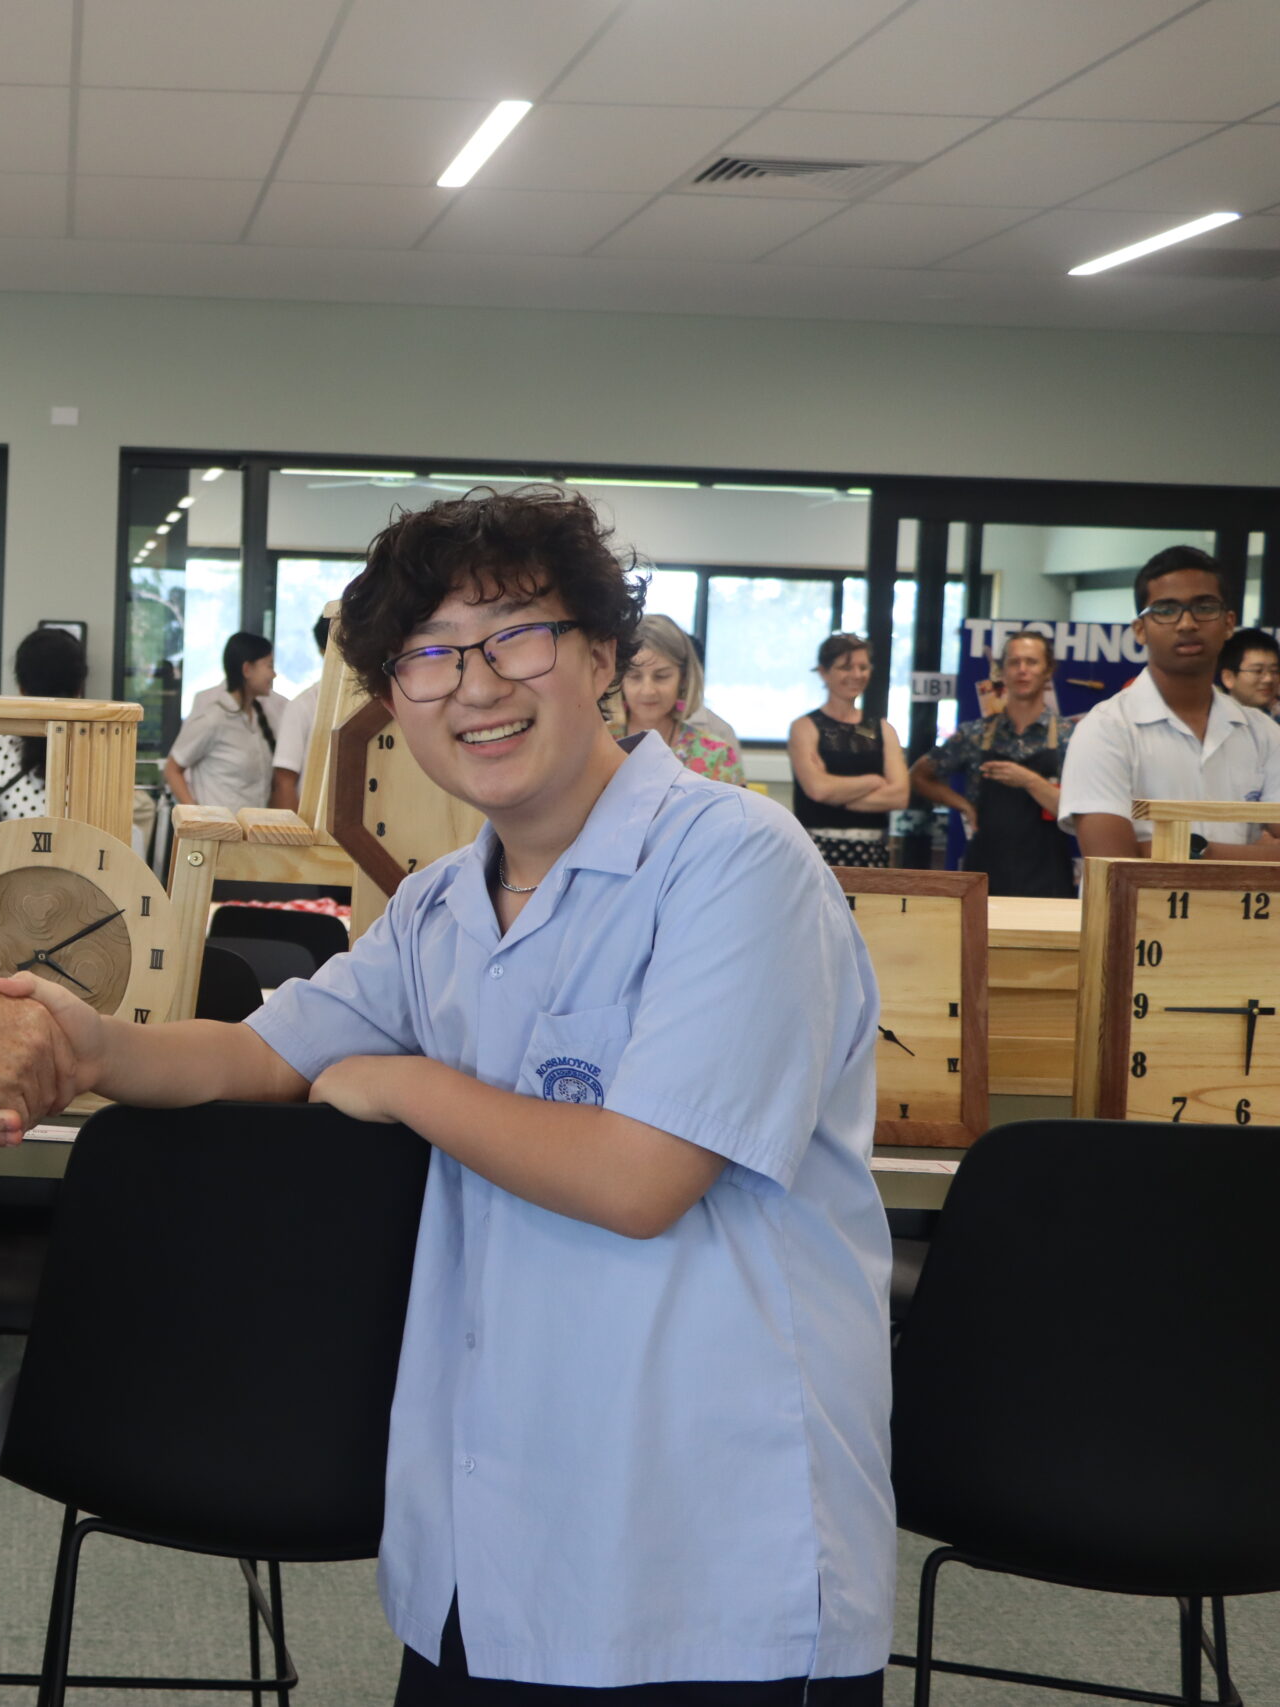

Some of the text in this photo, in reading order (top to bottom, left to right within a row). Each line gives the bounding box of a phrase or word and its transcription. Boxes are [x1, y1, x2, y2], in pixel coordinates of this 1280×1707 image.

[378, 734, 394, 750] 10
[369, 778, 378, 792] 9
[376, 821, 386, 837] 8
[31, 832, 53, 853] XII
[98, 849, 105, 870] I
[408, 858, 417, 873] 7
[141, 896, 151, 916] II
[901, 898, 907, 912] I
[1167, 892, 1189, 919] 11
[1241, 893, 1270, 920] 12
[150, 948, 164, 970] III
[1136, 940, 1163, 967] 10
[134, 1008, 151, 1024] IV
[1133, 993, 1148, 1019] 9
[536, 1057, 601, 1078] ROSSMOYNE
[1131, 1052, 1147, 1078] 8
[1172, 1097, 1187, 1122] 7
[1236, 1099, 1251, 1125] 6
